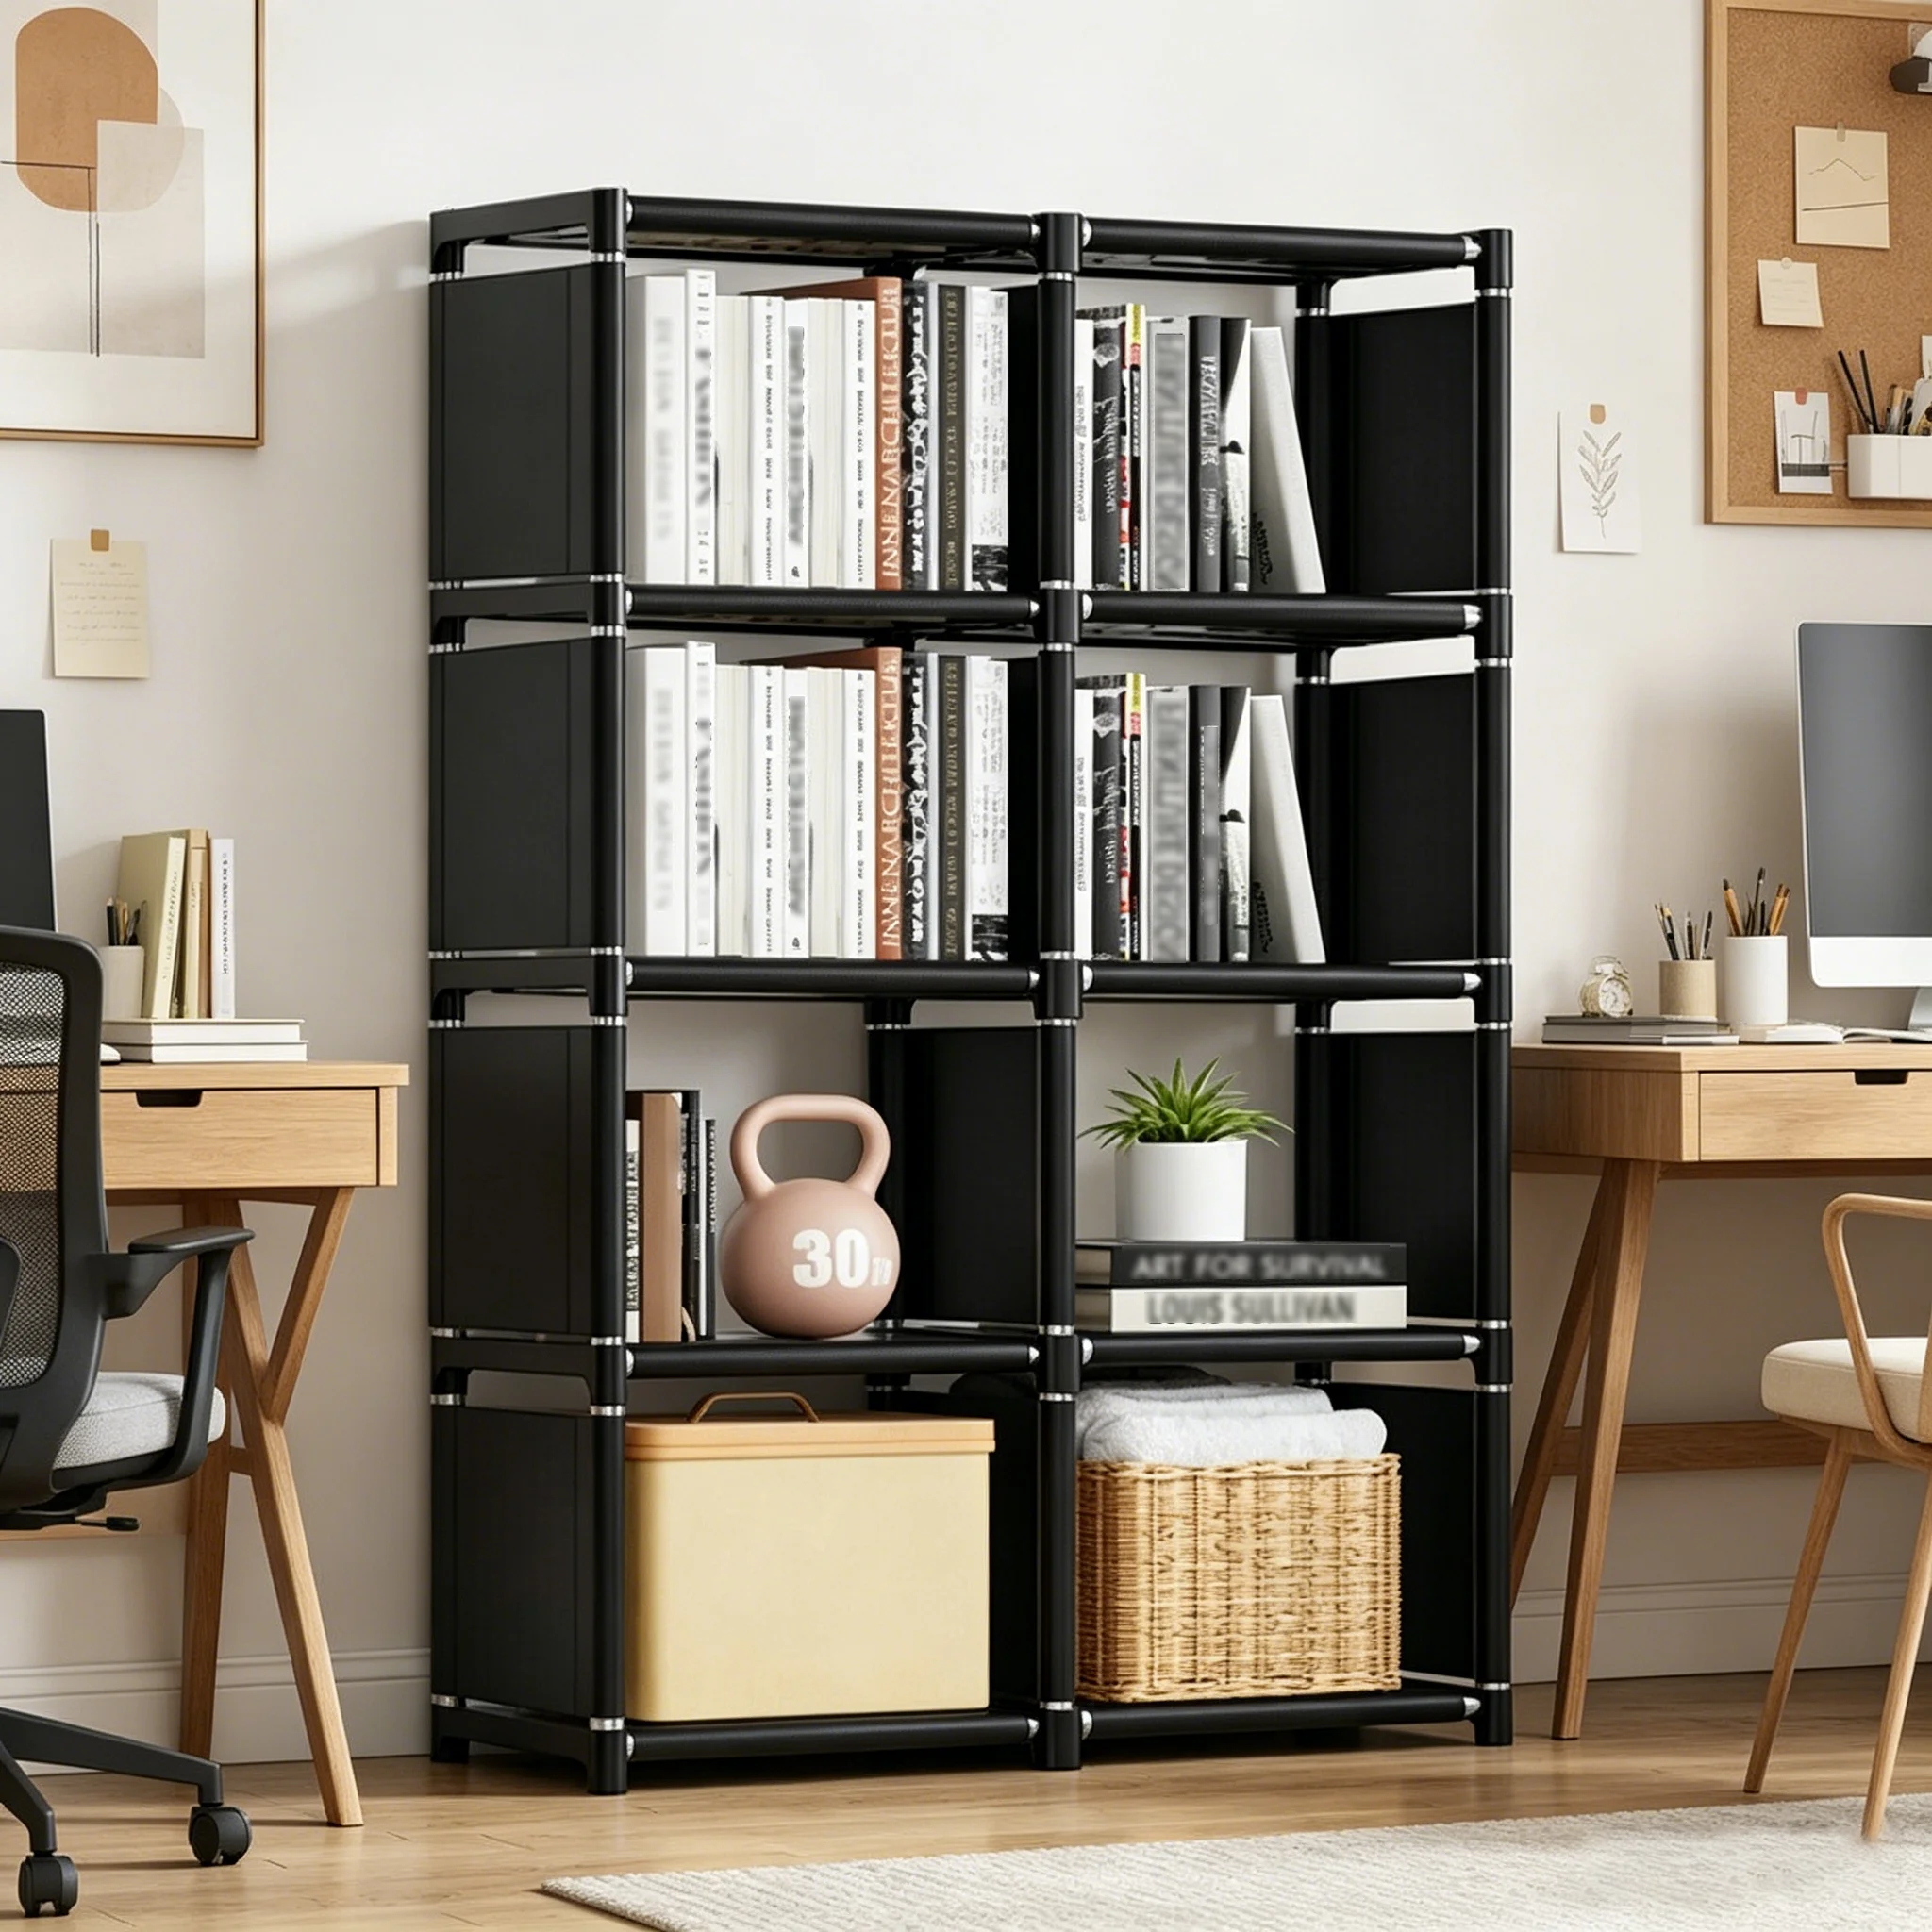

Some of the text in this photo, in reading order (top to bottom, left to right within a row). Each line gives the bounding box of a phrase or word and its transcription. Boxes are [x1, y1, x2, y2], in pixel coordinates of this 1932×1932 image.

[792, 1228, 870, 1289] 30
[1132, 1253, 1386, 1279] ART FOR SURVIVAL
[1146, 1291, 1356, 1324] LOUIS SULLIVAN
